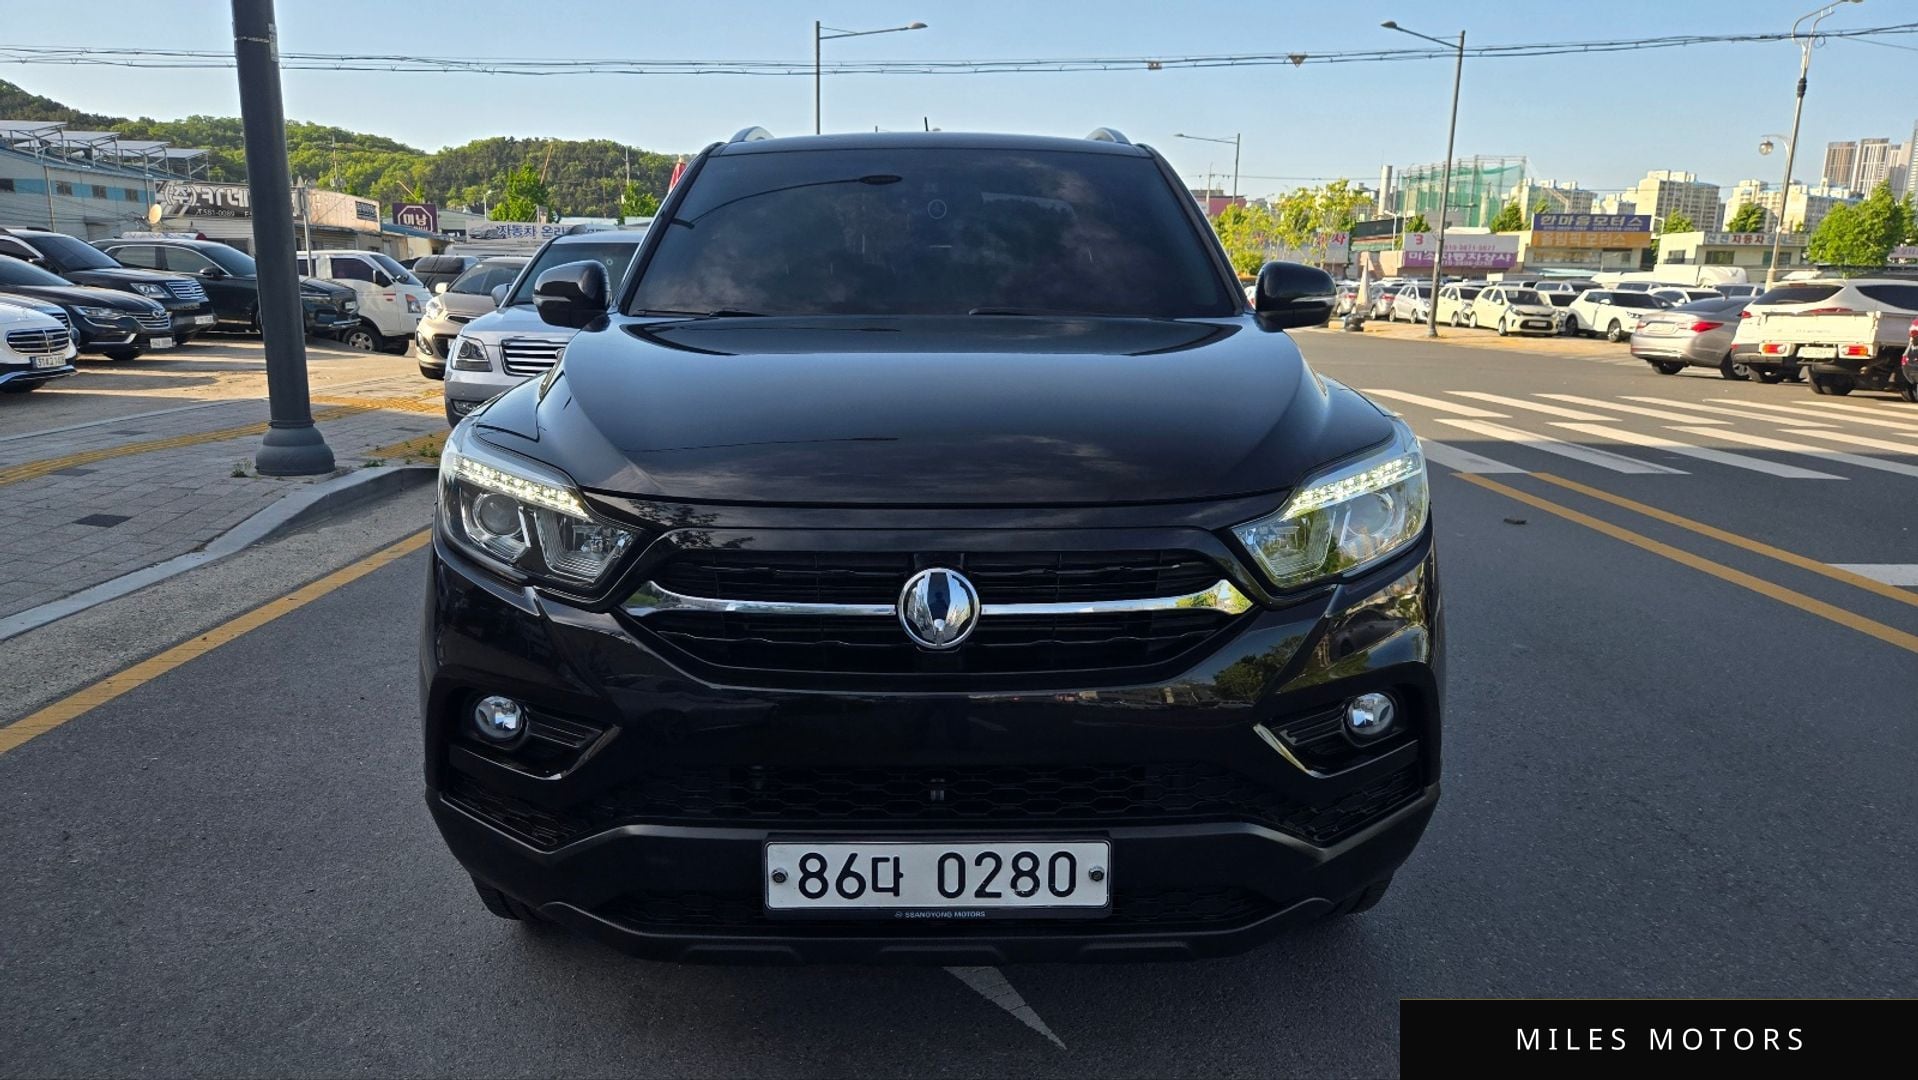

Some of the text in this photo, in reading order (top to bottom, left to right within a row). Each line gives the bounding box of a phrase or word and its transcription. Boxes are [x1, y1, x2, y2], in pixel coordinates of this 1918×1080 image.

[498, 224, 537, 239] 자동차
[798, 850, 1078, 900] 86다 0280
[904, 910, 986, 919] SSANGYONG MOTORS
